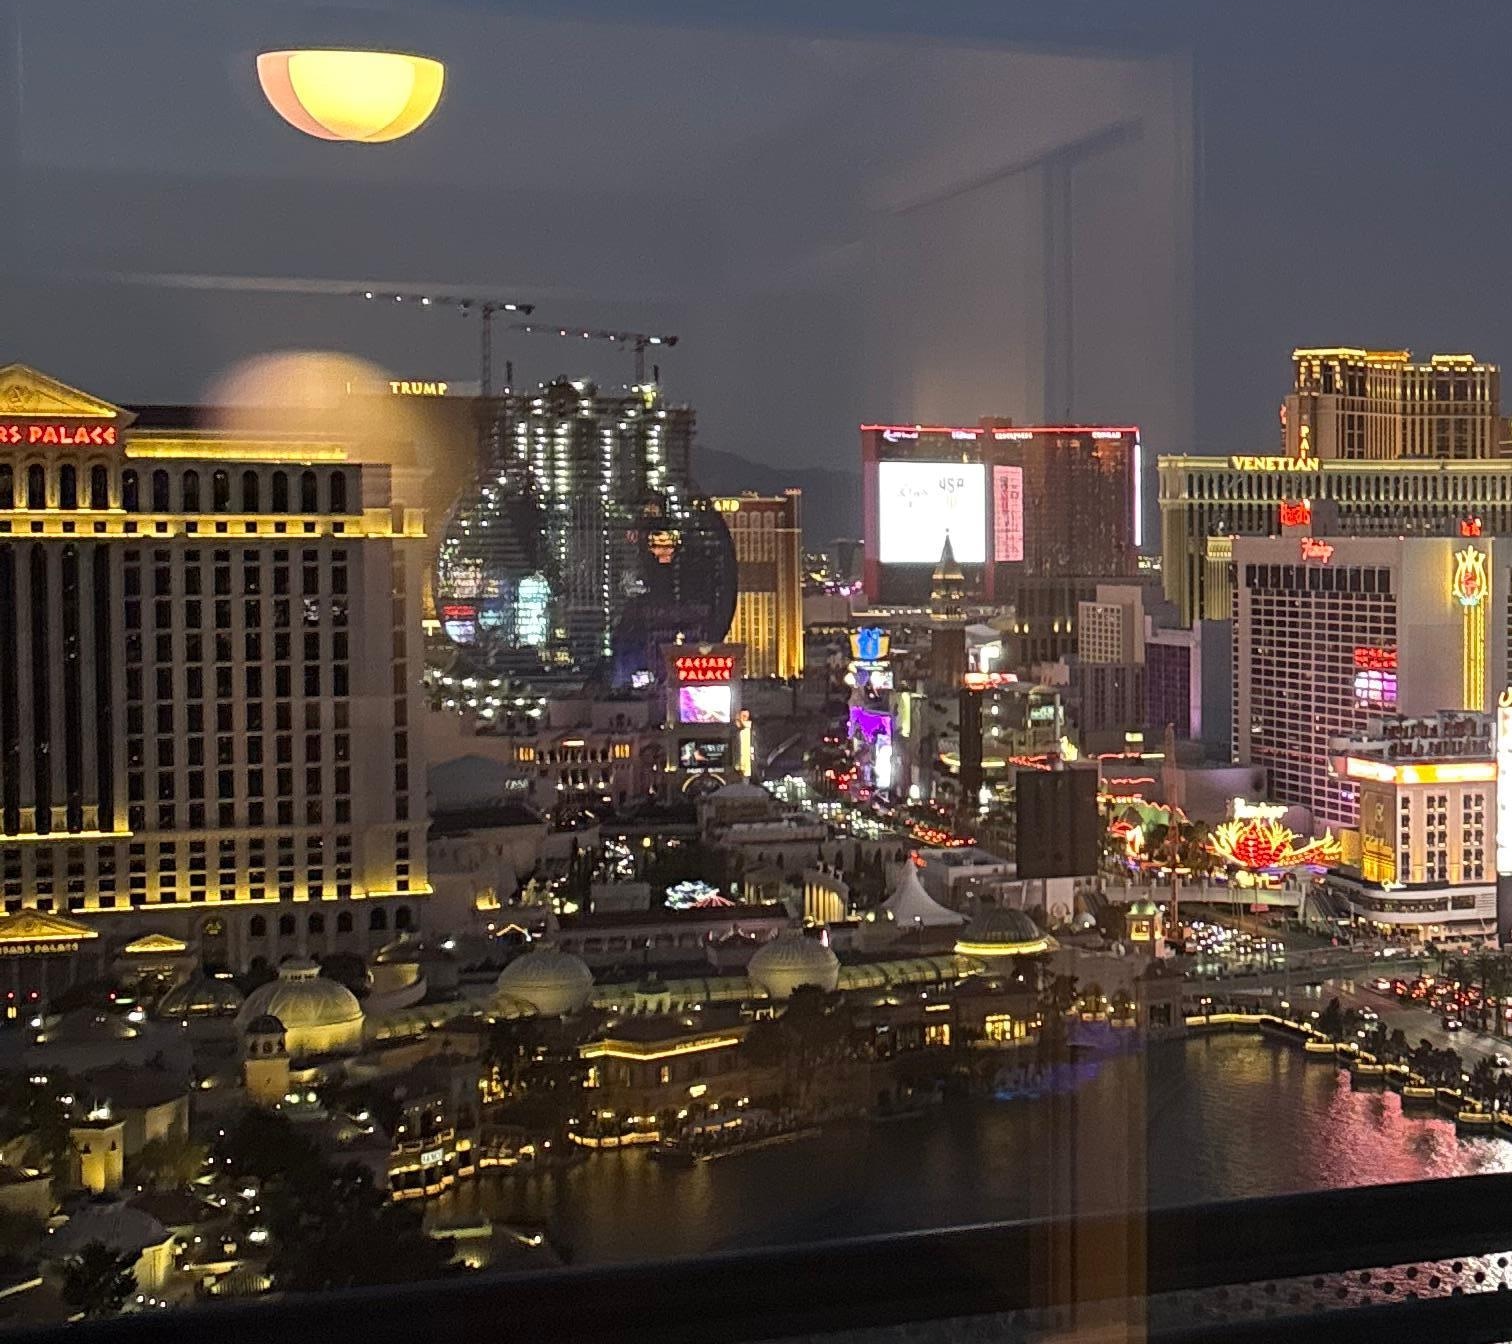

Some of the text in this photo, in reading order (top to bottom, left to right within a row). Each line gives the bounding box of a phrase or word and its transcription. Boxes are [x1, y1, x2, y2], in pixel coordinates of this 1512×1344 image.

[389, 381, 448, 396] TRUMP
[29, 425, 116, 445] PALACE
[1232, 456, 1319, 471] VENETIAN
[676, 657, 733, 668] CAESARS
[679, 669, 730, 680] PALACE
